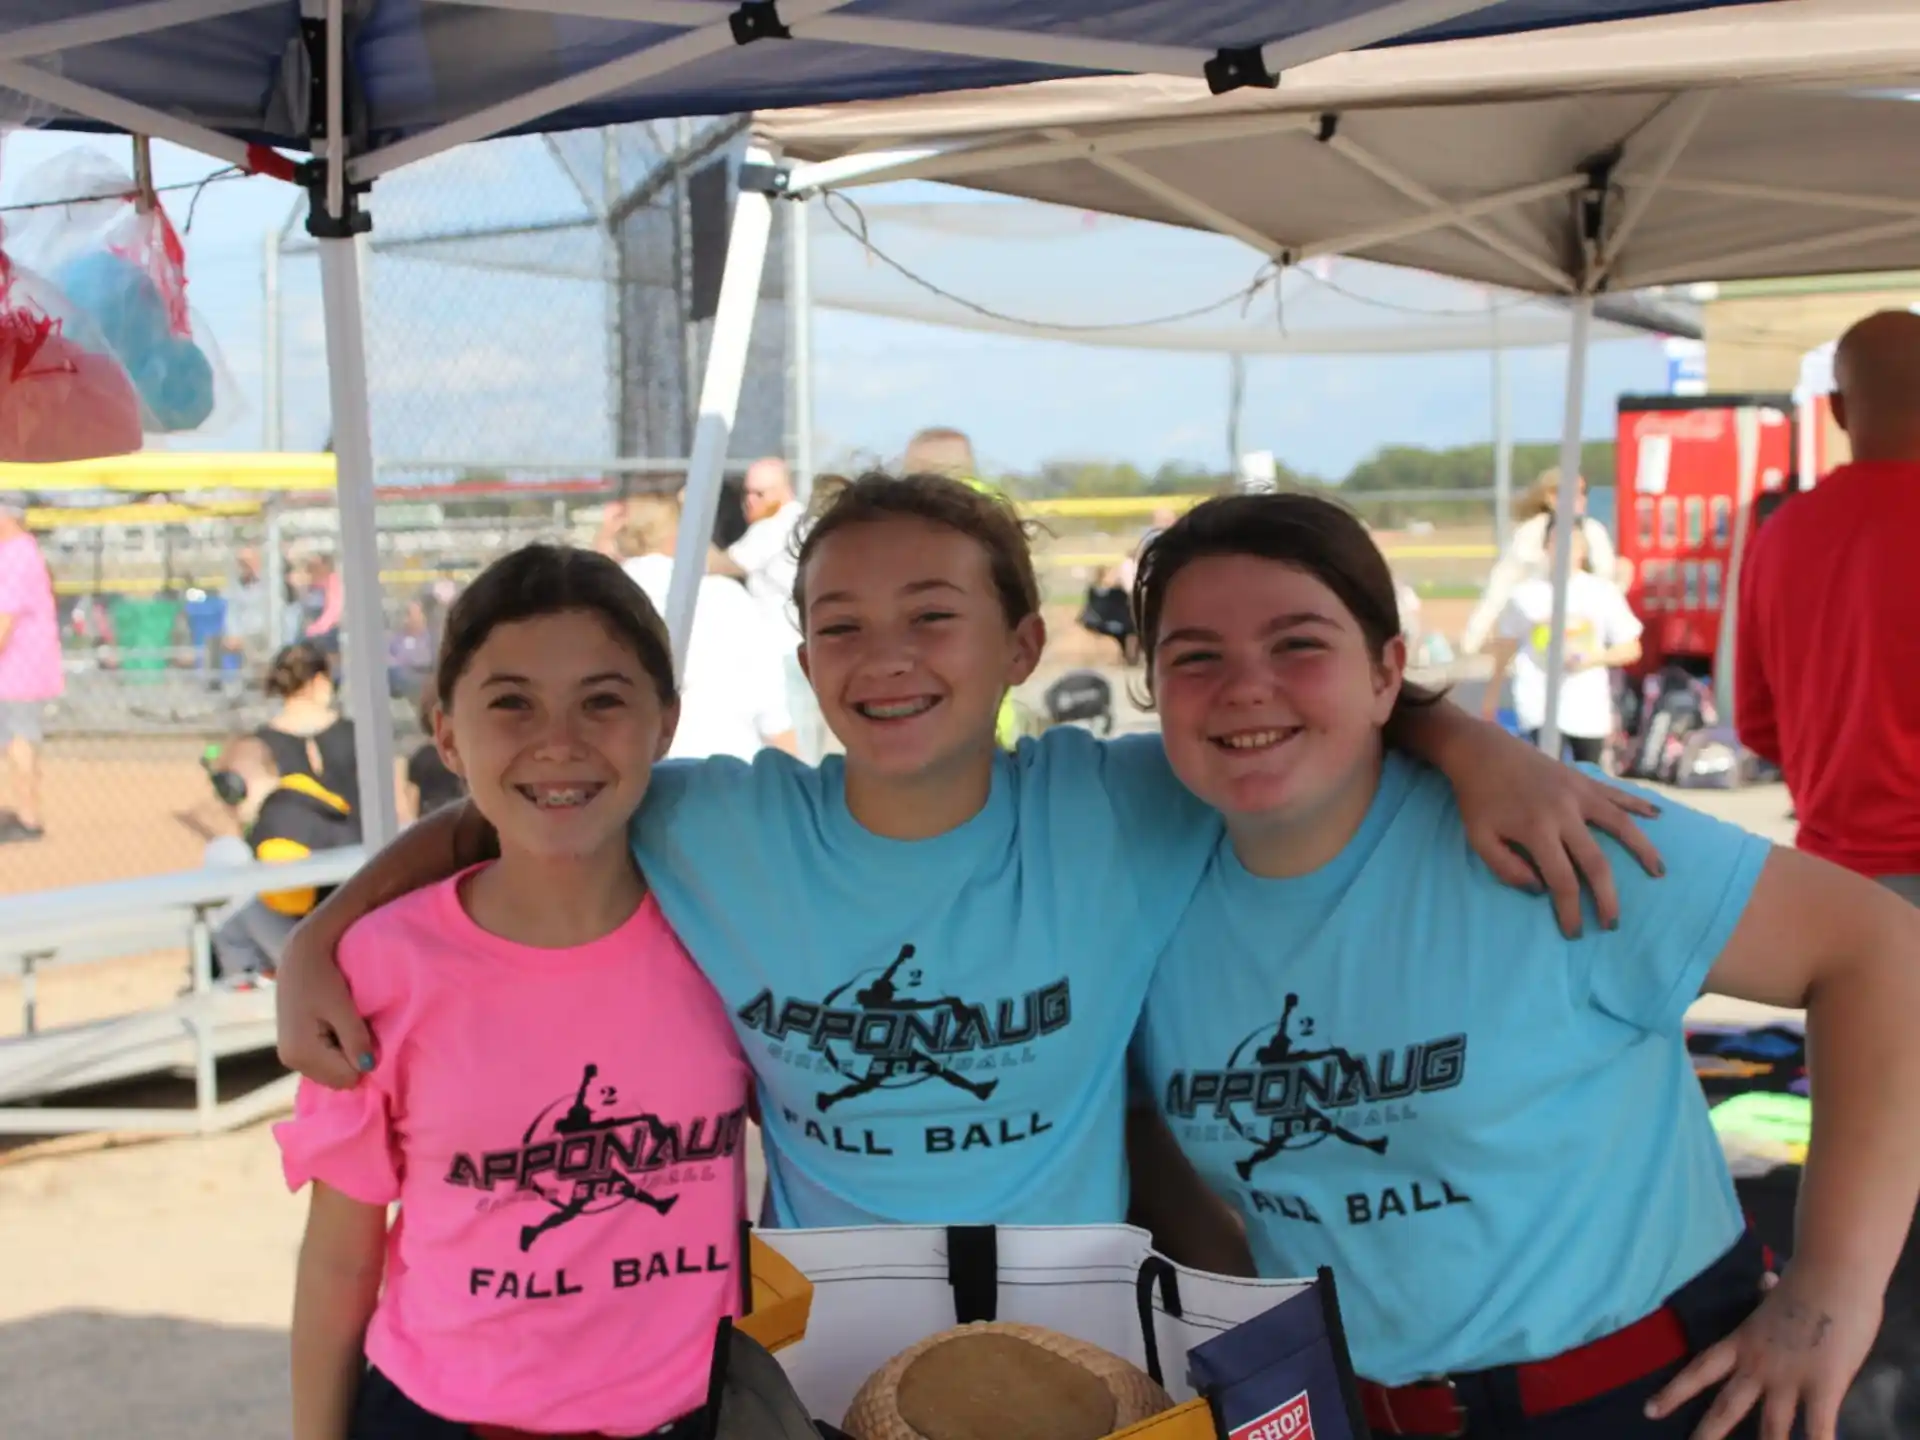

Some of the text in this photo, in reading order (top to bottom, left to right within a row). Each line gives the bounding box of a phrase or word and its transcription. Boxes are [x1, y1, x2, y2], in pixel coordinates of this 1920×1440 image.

[738, 975, 1072, 1057] APPONAUG
[1166, 1032, 1467, 1120] APPONAUG
[925, 1112, 1053, 1154] BALL
[1346, 1179, 1472, 1225] BALL
[470, 1244, 730, 1299] FALL BALL
